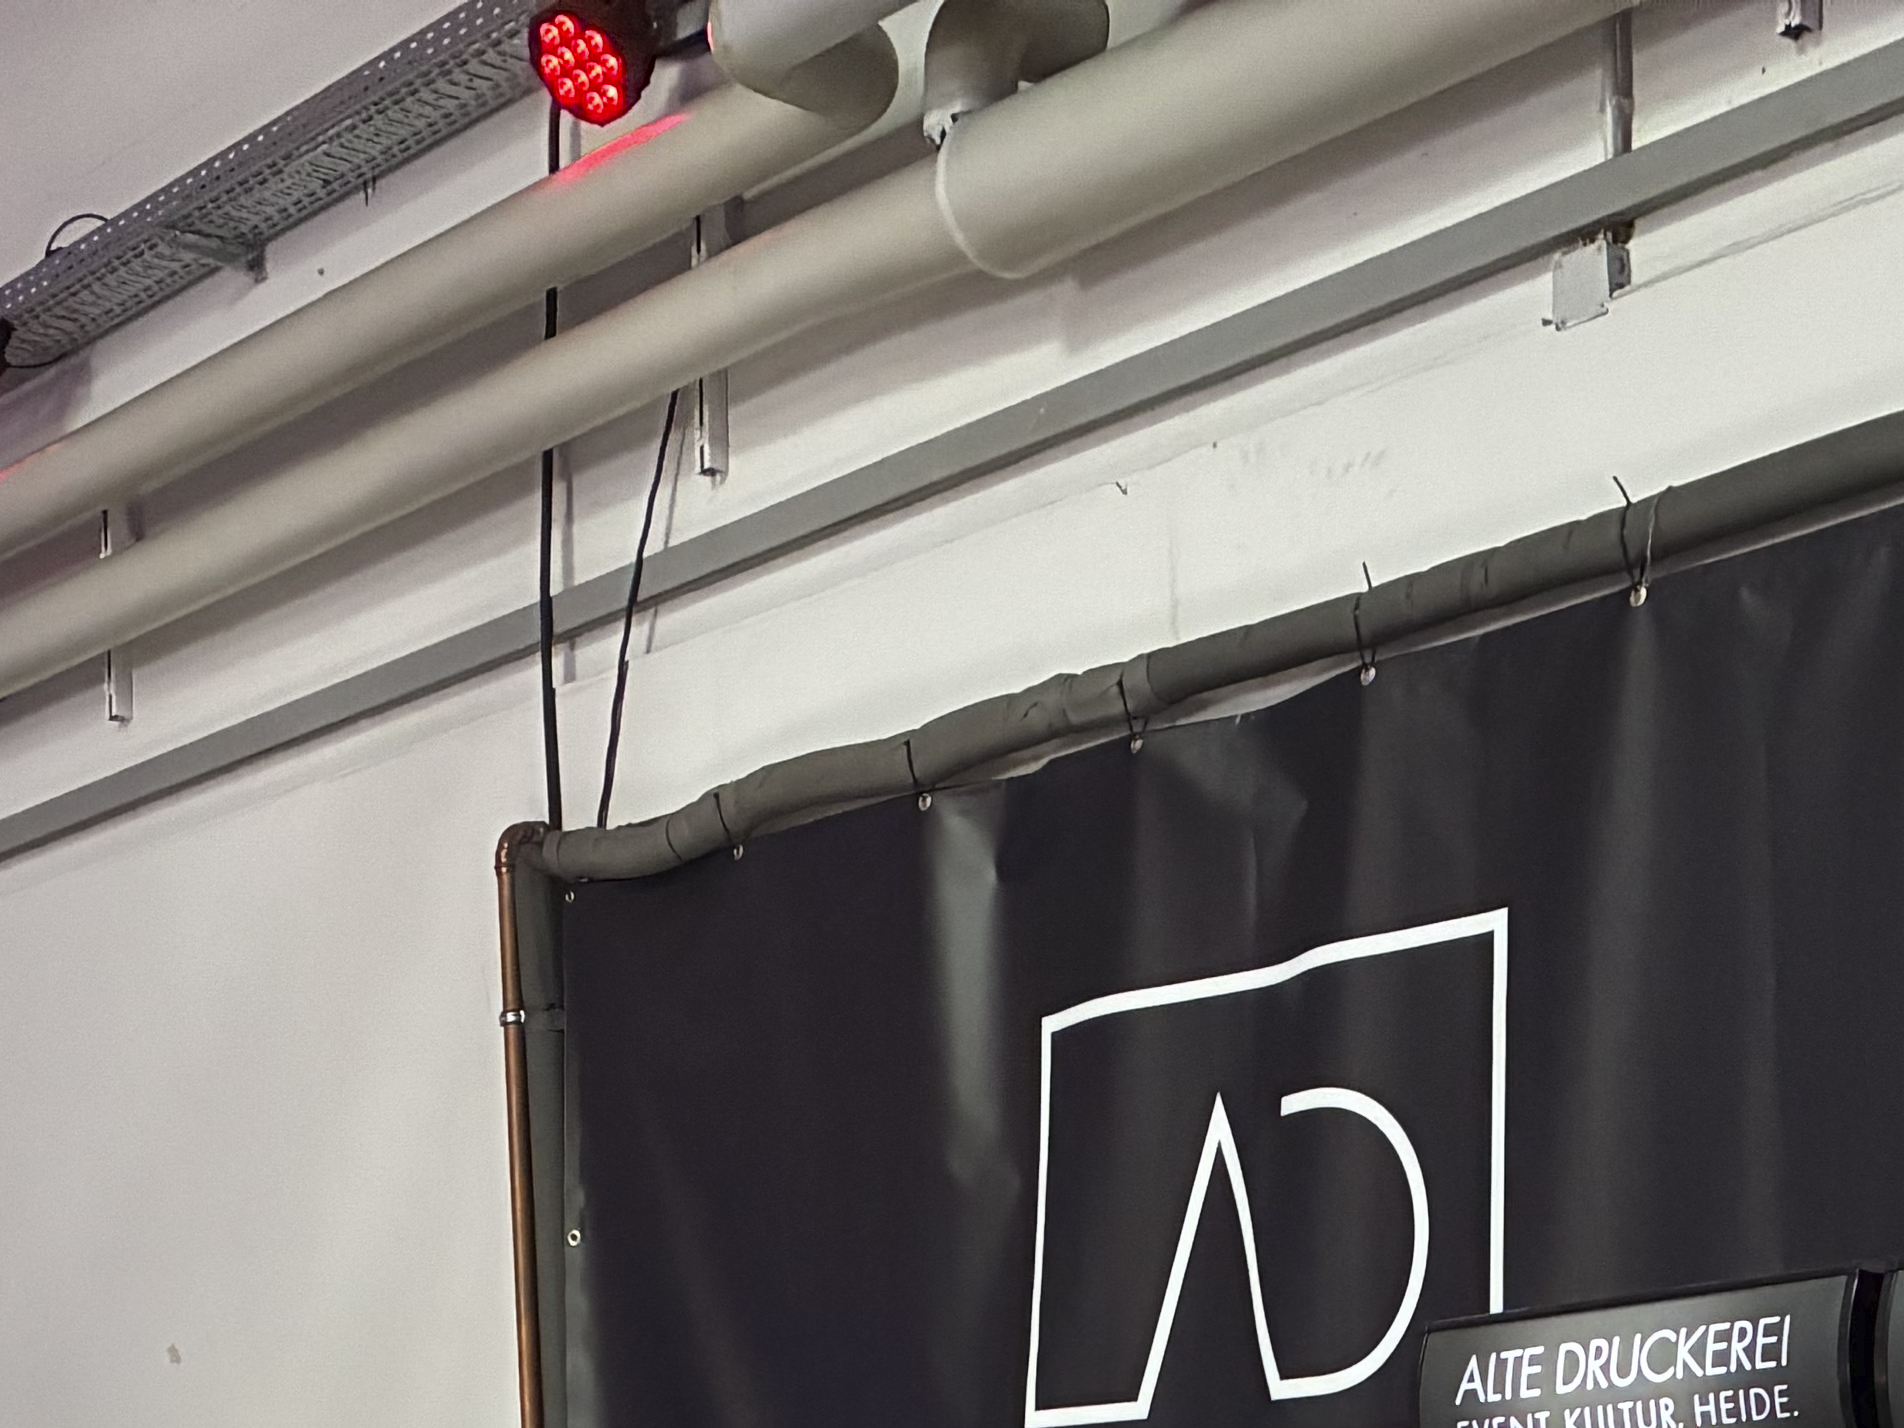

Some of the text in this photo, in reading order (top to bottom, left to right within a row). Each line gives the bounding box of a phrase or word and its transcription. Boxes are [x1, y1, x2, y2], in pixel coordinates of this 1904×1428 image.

[1455, 1314, 1791, 1406] ALTE DRUCKEREI
[1694, 1384, 1800, 1427] HEIDE.
